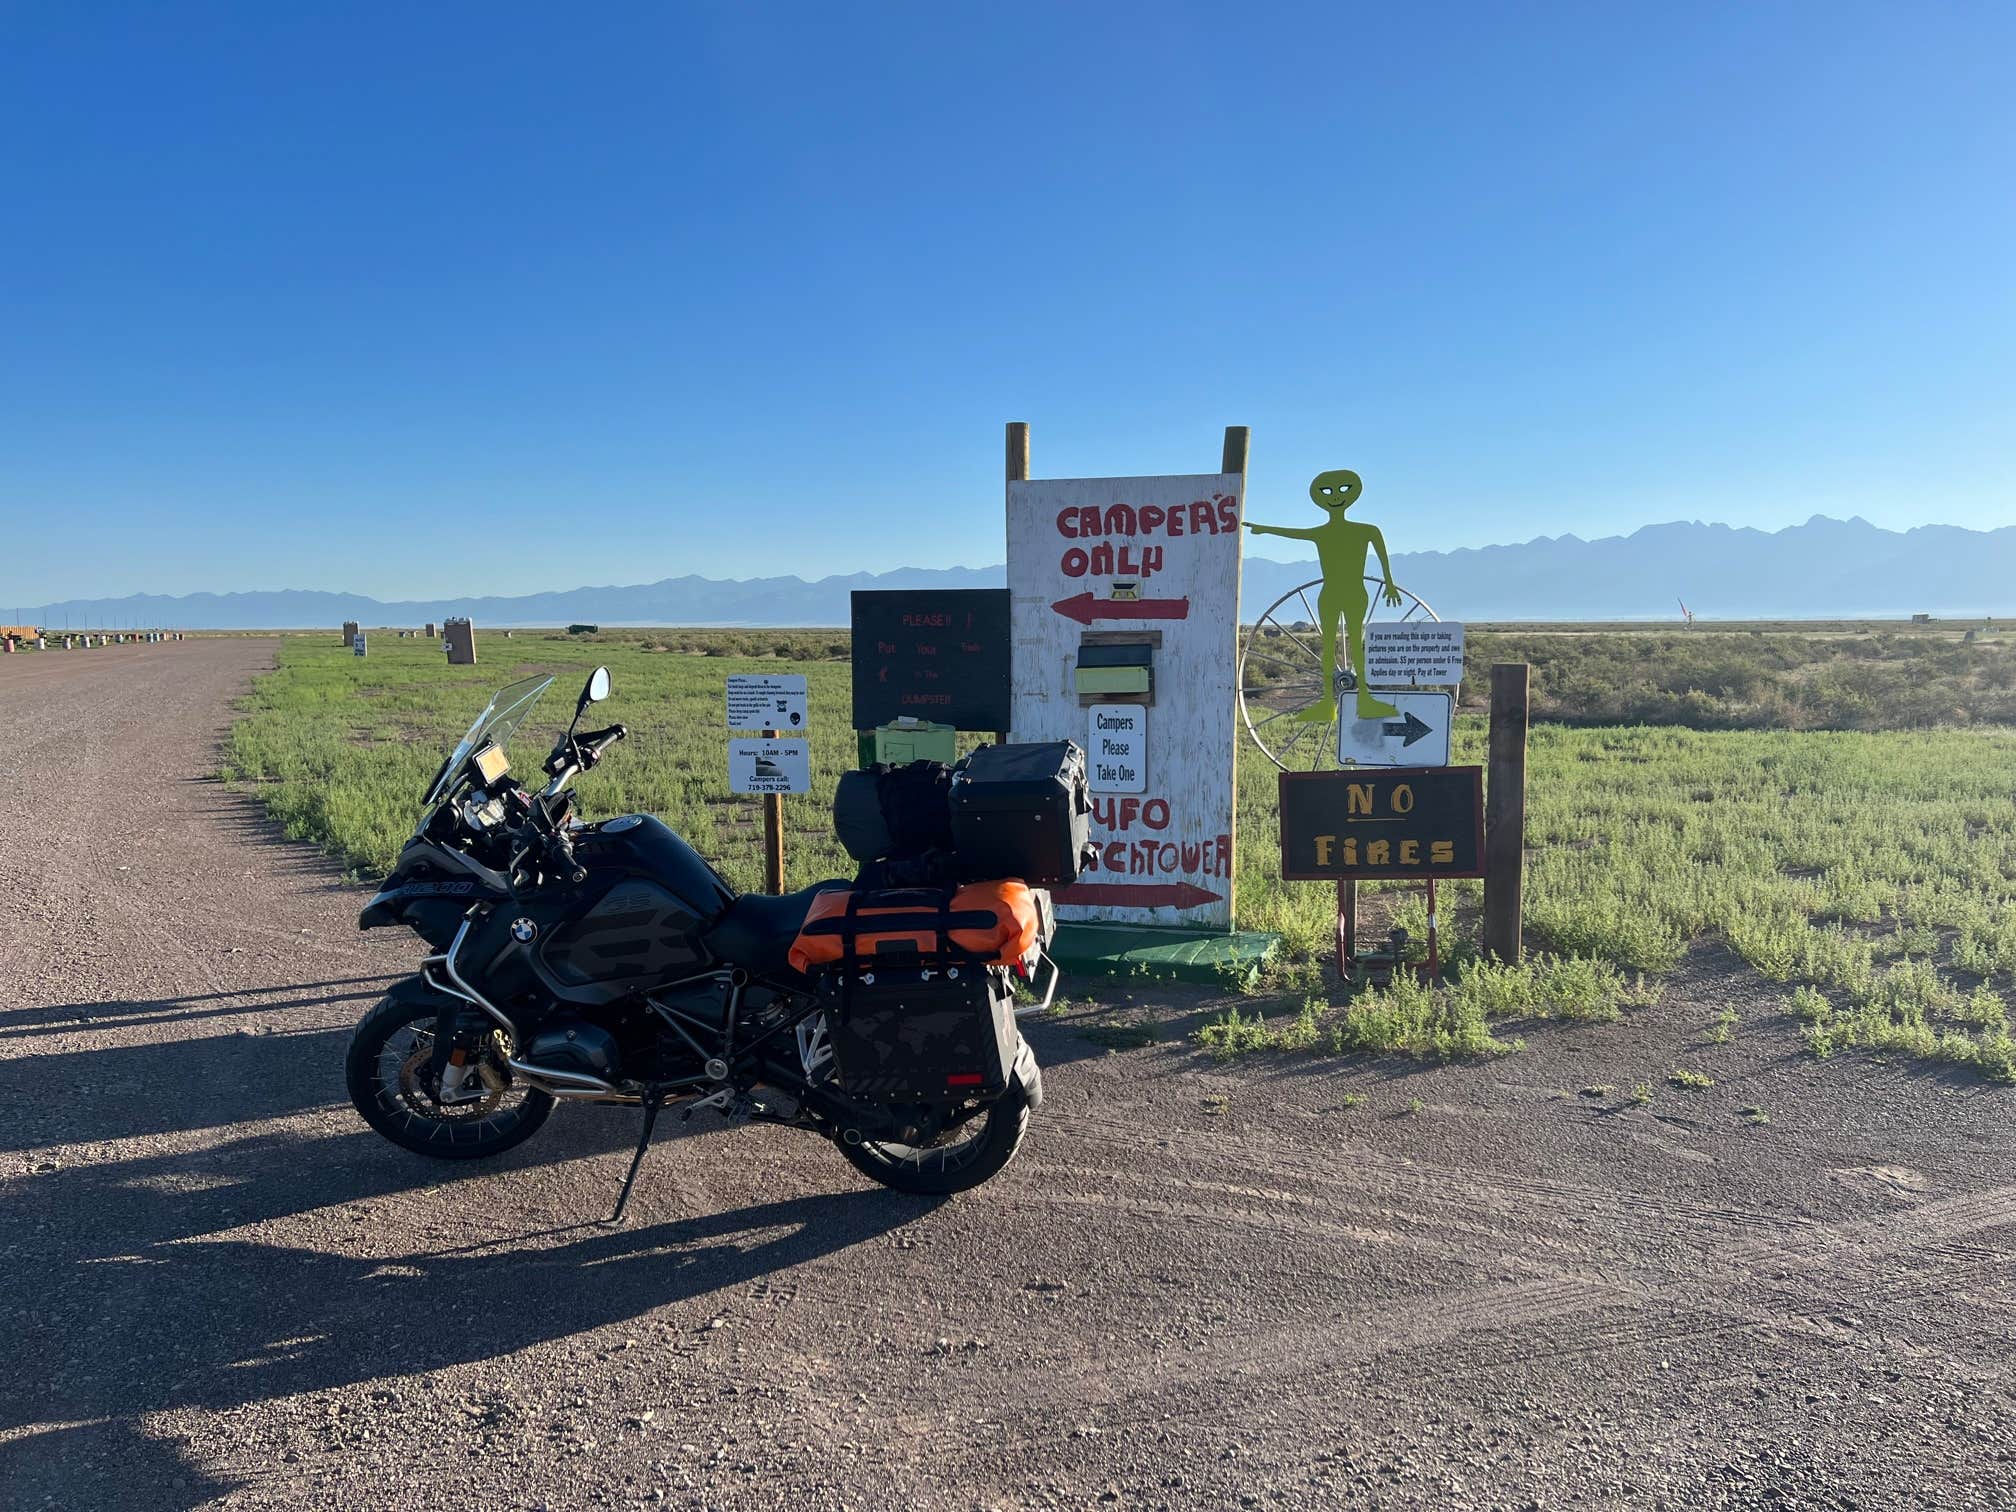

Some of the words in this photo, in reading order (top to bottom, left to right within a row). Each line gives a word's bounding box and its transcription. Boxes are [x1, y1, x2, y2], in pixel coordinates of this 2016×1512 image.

[1060, 540, 1163, 578] ONLY
[1392, 632, 1410, 641] reading
[1410, 632, 1419, 640] this
[1437, 632, 1452, 641] taking
[1368, 645, 1386, 653] pictures
[1421, 644, 1440, 653] property
[1371, 668, 1387, 677] Applies
[1418, 668, 1426, 677] Pay
[1433, 668, 1447, 676] Tower
[1097, 713, 1133, 732] Campers
[1102, 740, 1129, 756] Please
[1097, 765, 1116, 780] Take
[1119, 765, 1134, 781] One
[1346, 784, 1414, 815] NO
[1092, 797, 1170, 832] UFO
